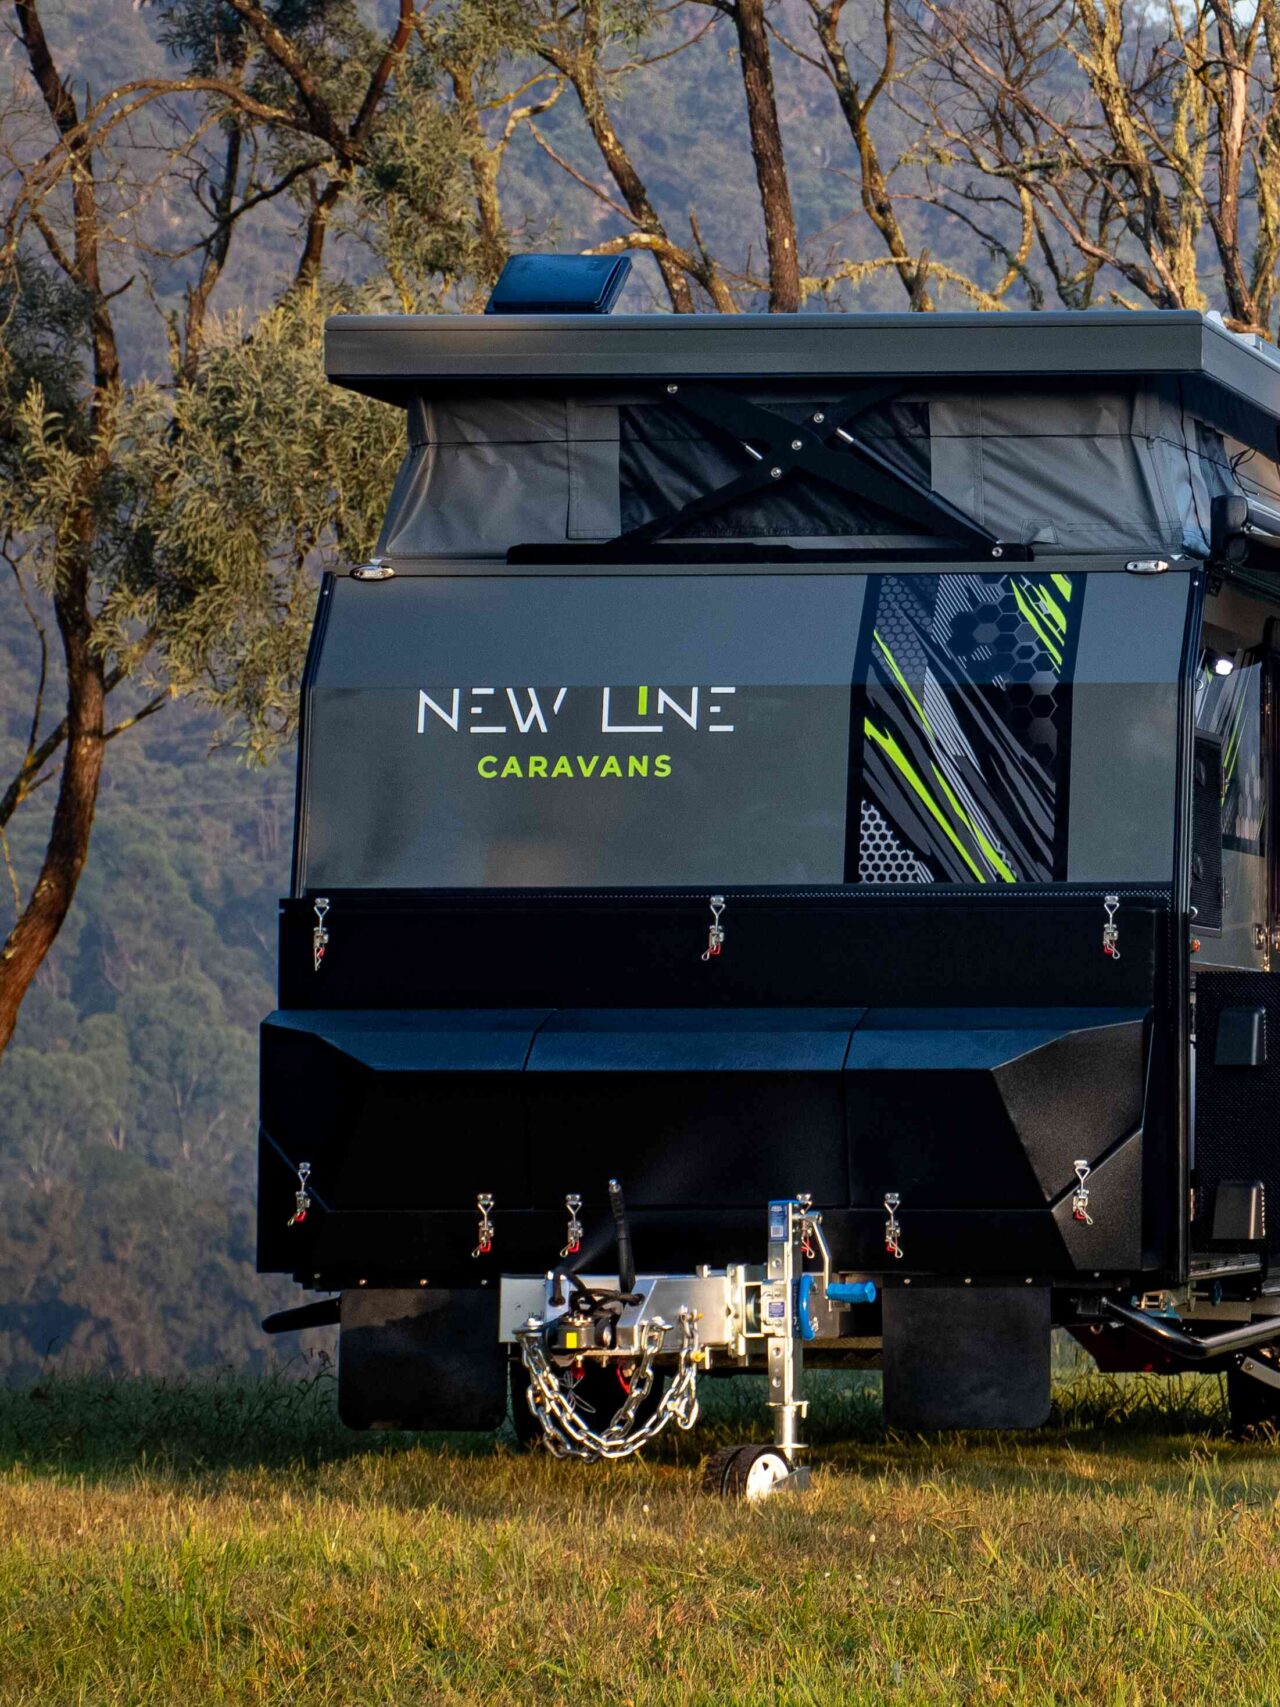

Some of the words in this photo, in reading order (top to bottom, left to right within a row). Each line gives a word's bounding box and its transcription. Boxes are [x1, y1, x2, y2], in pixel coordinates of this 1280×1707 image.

[418, 686, 567, 733] NEW
[602, 686, 736, 733] LINE
[478, 755, 672, 777] CARAVANS
